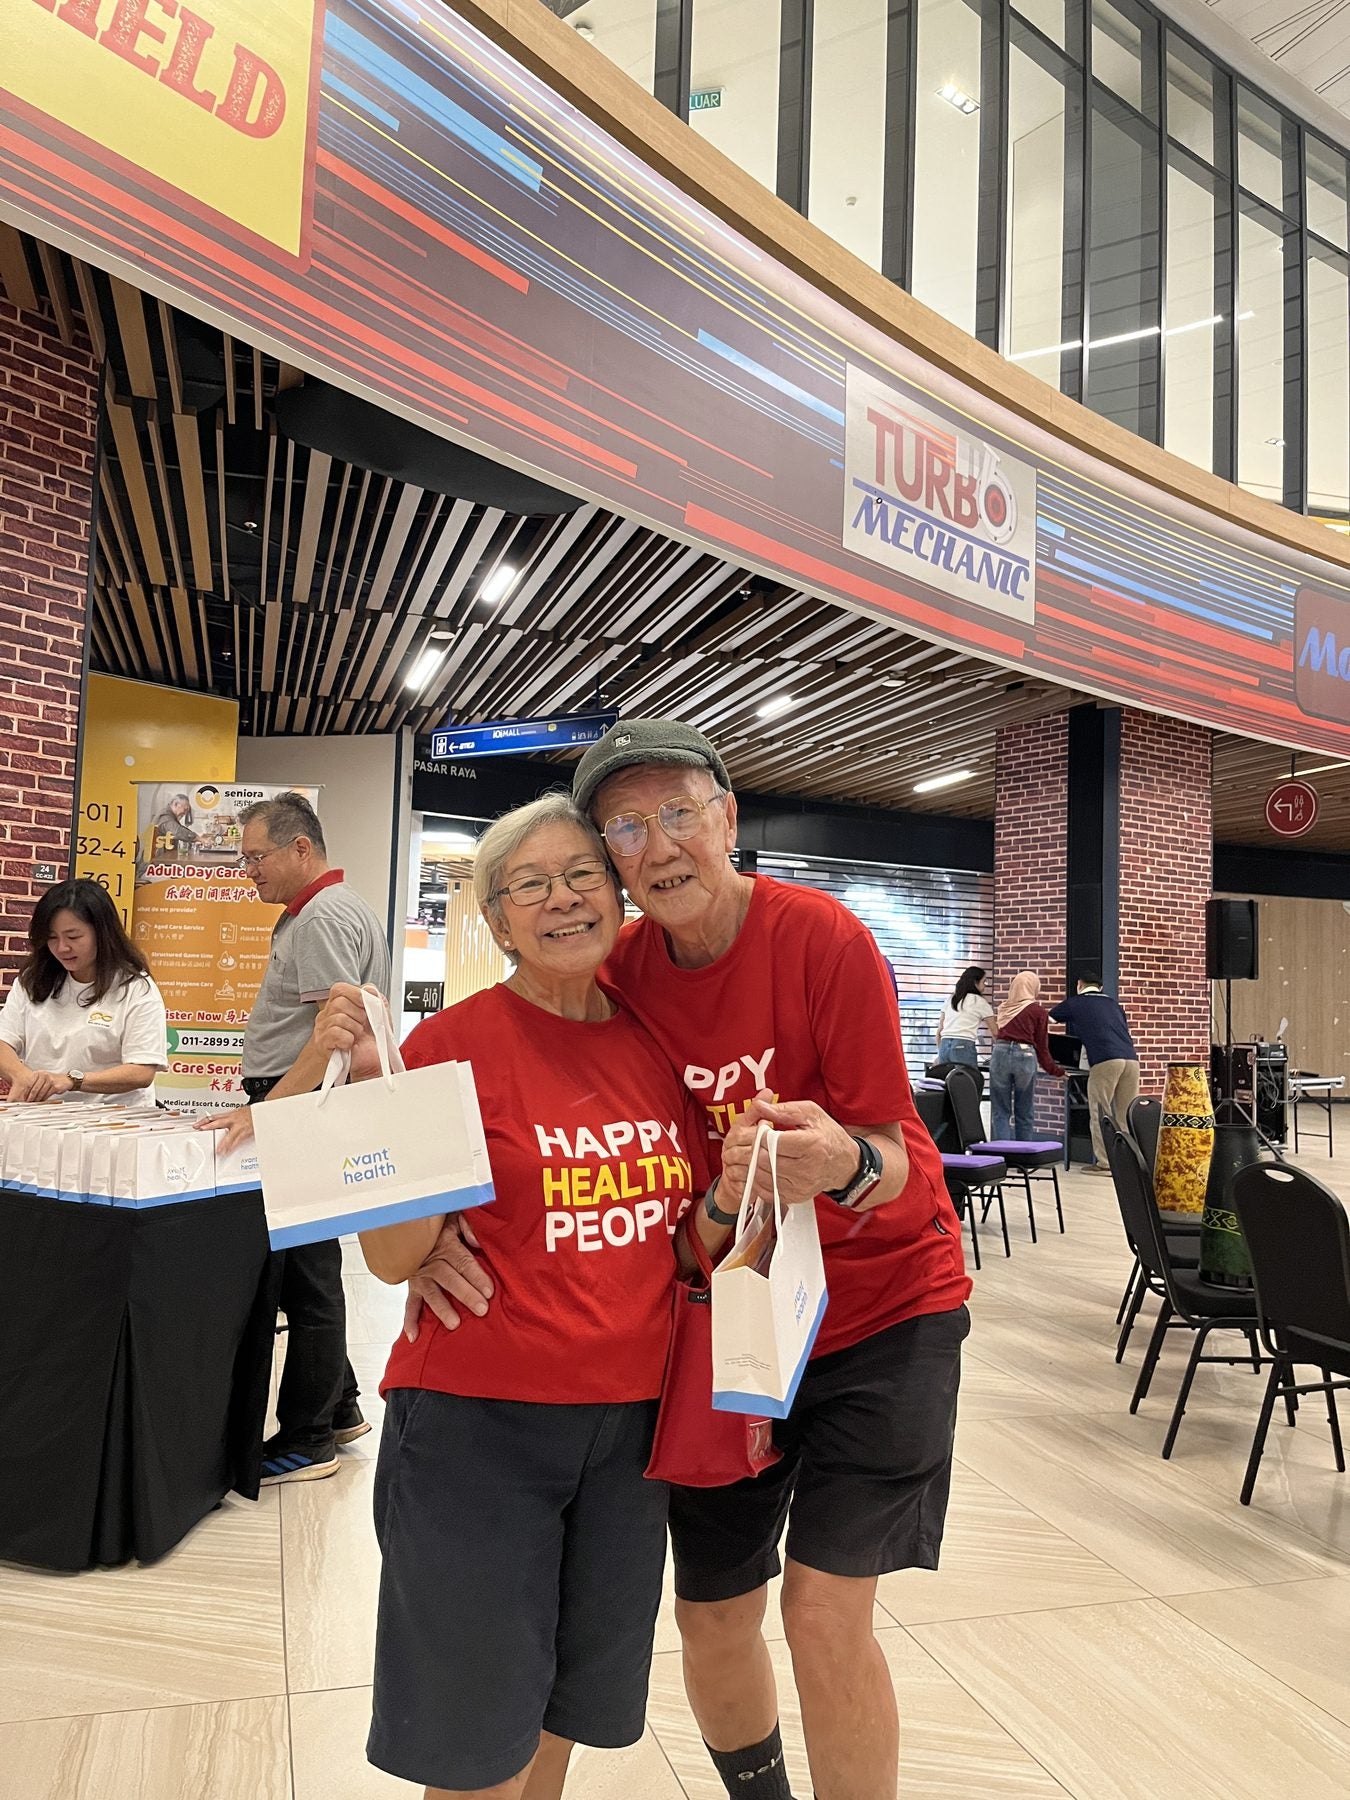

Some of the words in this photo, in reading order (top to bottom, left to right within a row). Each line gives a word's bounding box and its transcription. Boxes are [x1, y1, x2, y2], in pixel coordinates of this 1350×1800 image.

[33, 0, 286, 139] ELD
[852, 495, 1030, 601] MECHANIC
[414, 760, 448, 774] PASAR
[450, 765, 477, 779] RAYA
[224, 789, 264, 797] seniora
[40, 865, 50, 873] 24
[146, 864, 182, 876] Adult
[186, 866, 213, 879] Day
[216, 868, 247, 878] Care
[197, 1012, 221, 1020] Now
[182, 1036, 230, 1046] 011-2899
[172, 1062, 204, 1073] Care
[534, 1120, 682, 1159] HAPPY
[342, 1148, 390, 1170] Avant
[343, 1163, 396, 1184] health
